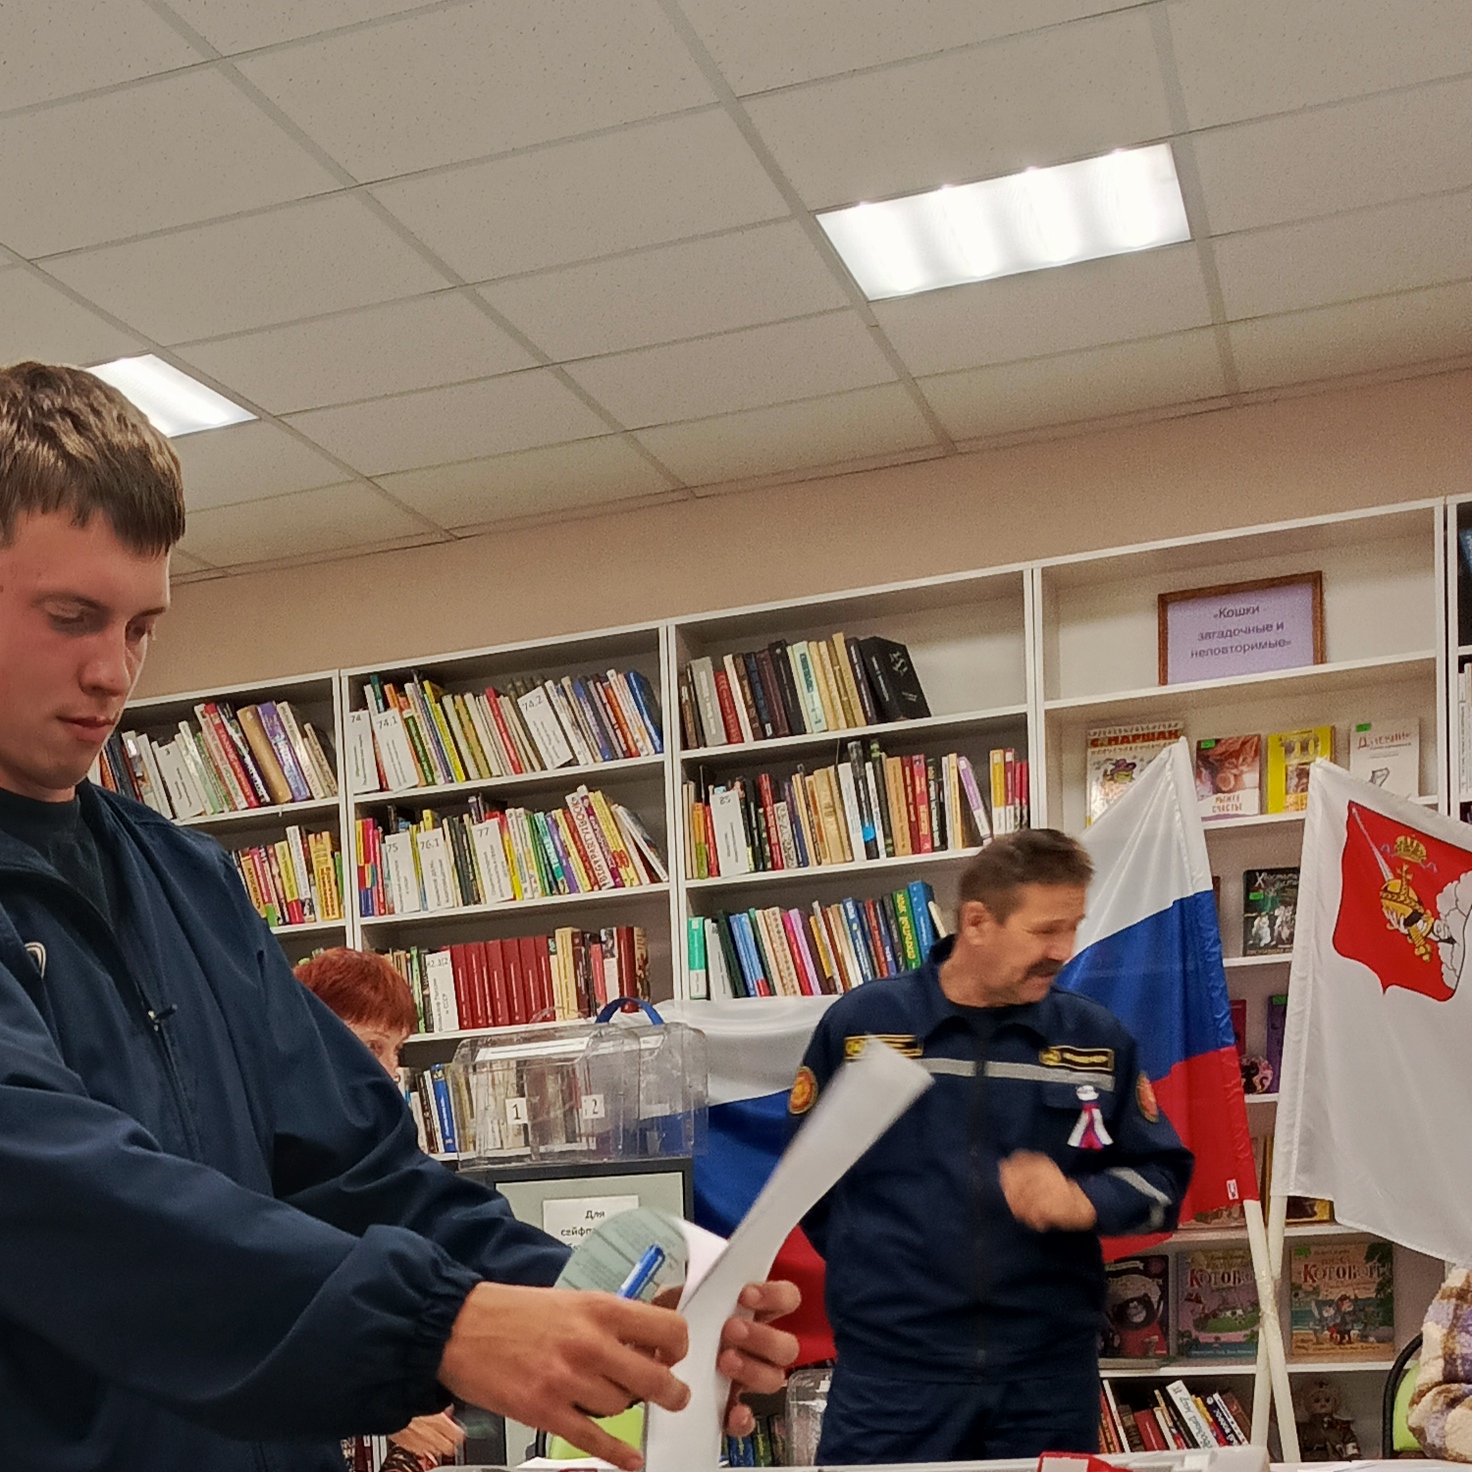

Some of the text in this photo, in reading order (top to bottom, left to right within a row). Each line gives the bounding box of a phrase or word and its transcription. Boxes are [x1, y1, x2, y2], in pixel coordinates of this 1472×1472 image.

[1198, 621, 1285, 641] загадочные и
[350, 713, 362, 724] 74
[478, 827, 489, 838] 77
[387, 842, 399, 853] 75
[512, 1104, 521, 1120] 1
[592, 1099, 599, 1115] 2
[585, 1210, 605, 1219] Для
